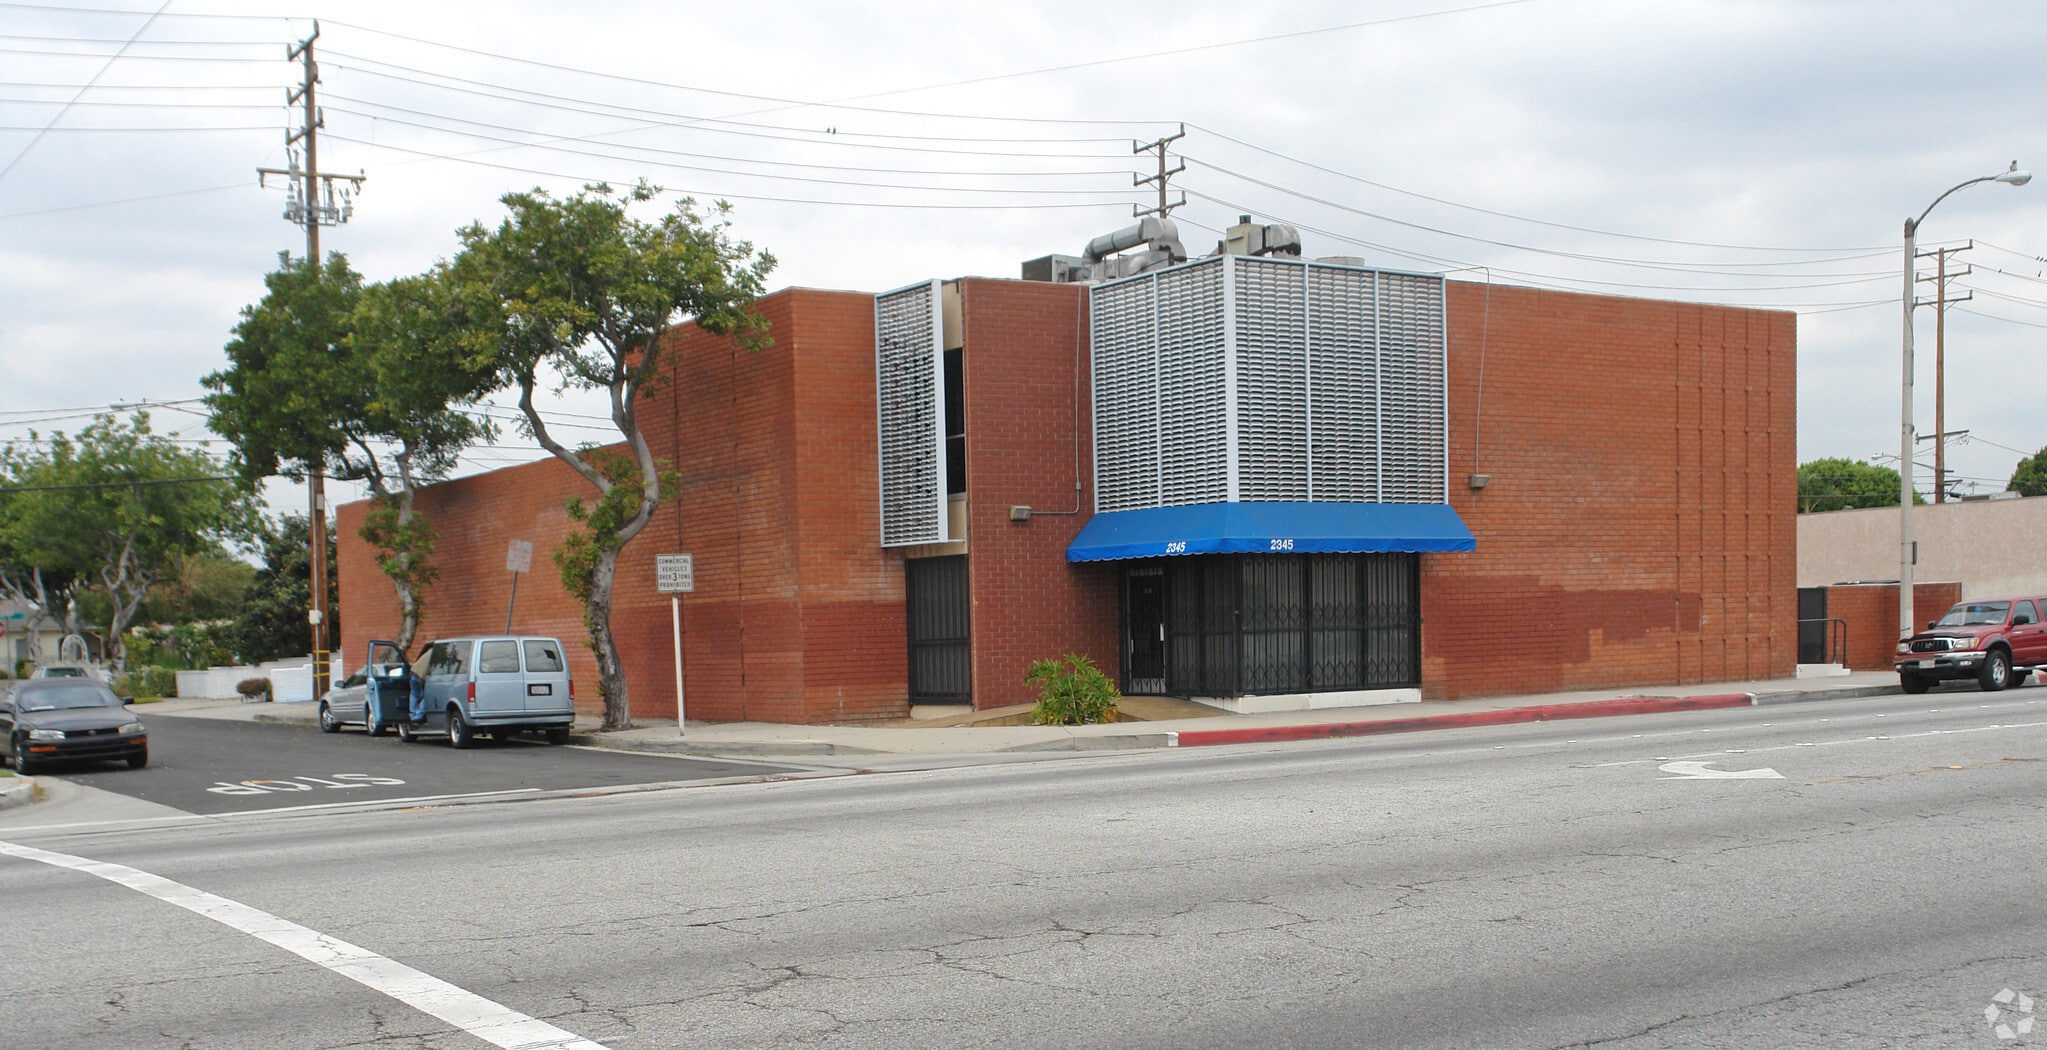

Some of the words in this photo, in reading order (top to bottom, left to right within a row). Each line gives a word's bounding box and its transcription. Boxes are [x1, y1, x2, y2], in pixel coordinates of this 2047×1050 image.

[1166, 541, 1186, 553] 2345
[1270, 539, 1294, 550] 2345
[672, 572, 678, 581] 3
[206, 773, 406, 795] STOP
